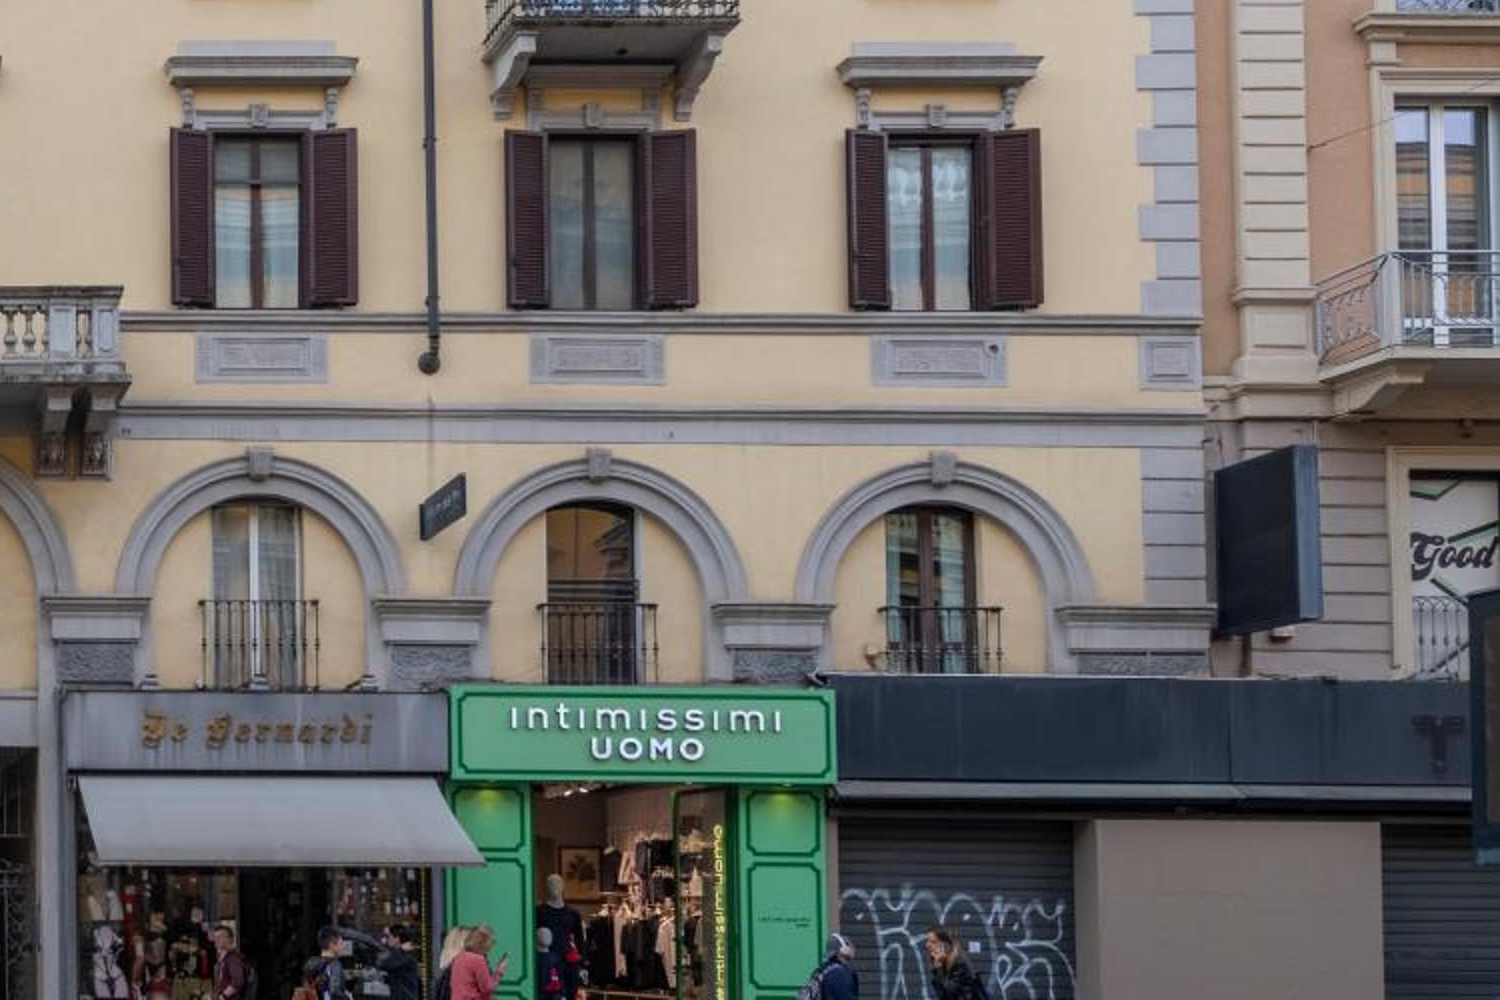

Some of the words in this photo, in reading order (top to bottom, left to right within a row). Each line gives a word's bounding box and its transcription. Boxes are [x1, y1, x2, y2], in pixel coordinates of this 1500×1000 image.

[1411, 532, 1500, 581] Good
[510, 702, 782, 733] intimissimi
[590, 735, 705, 761] UOMO
